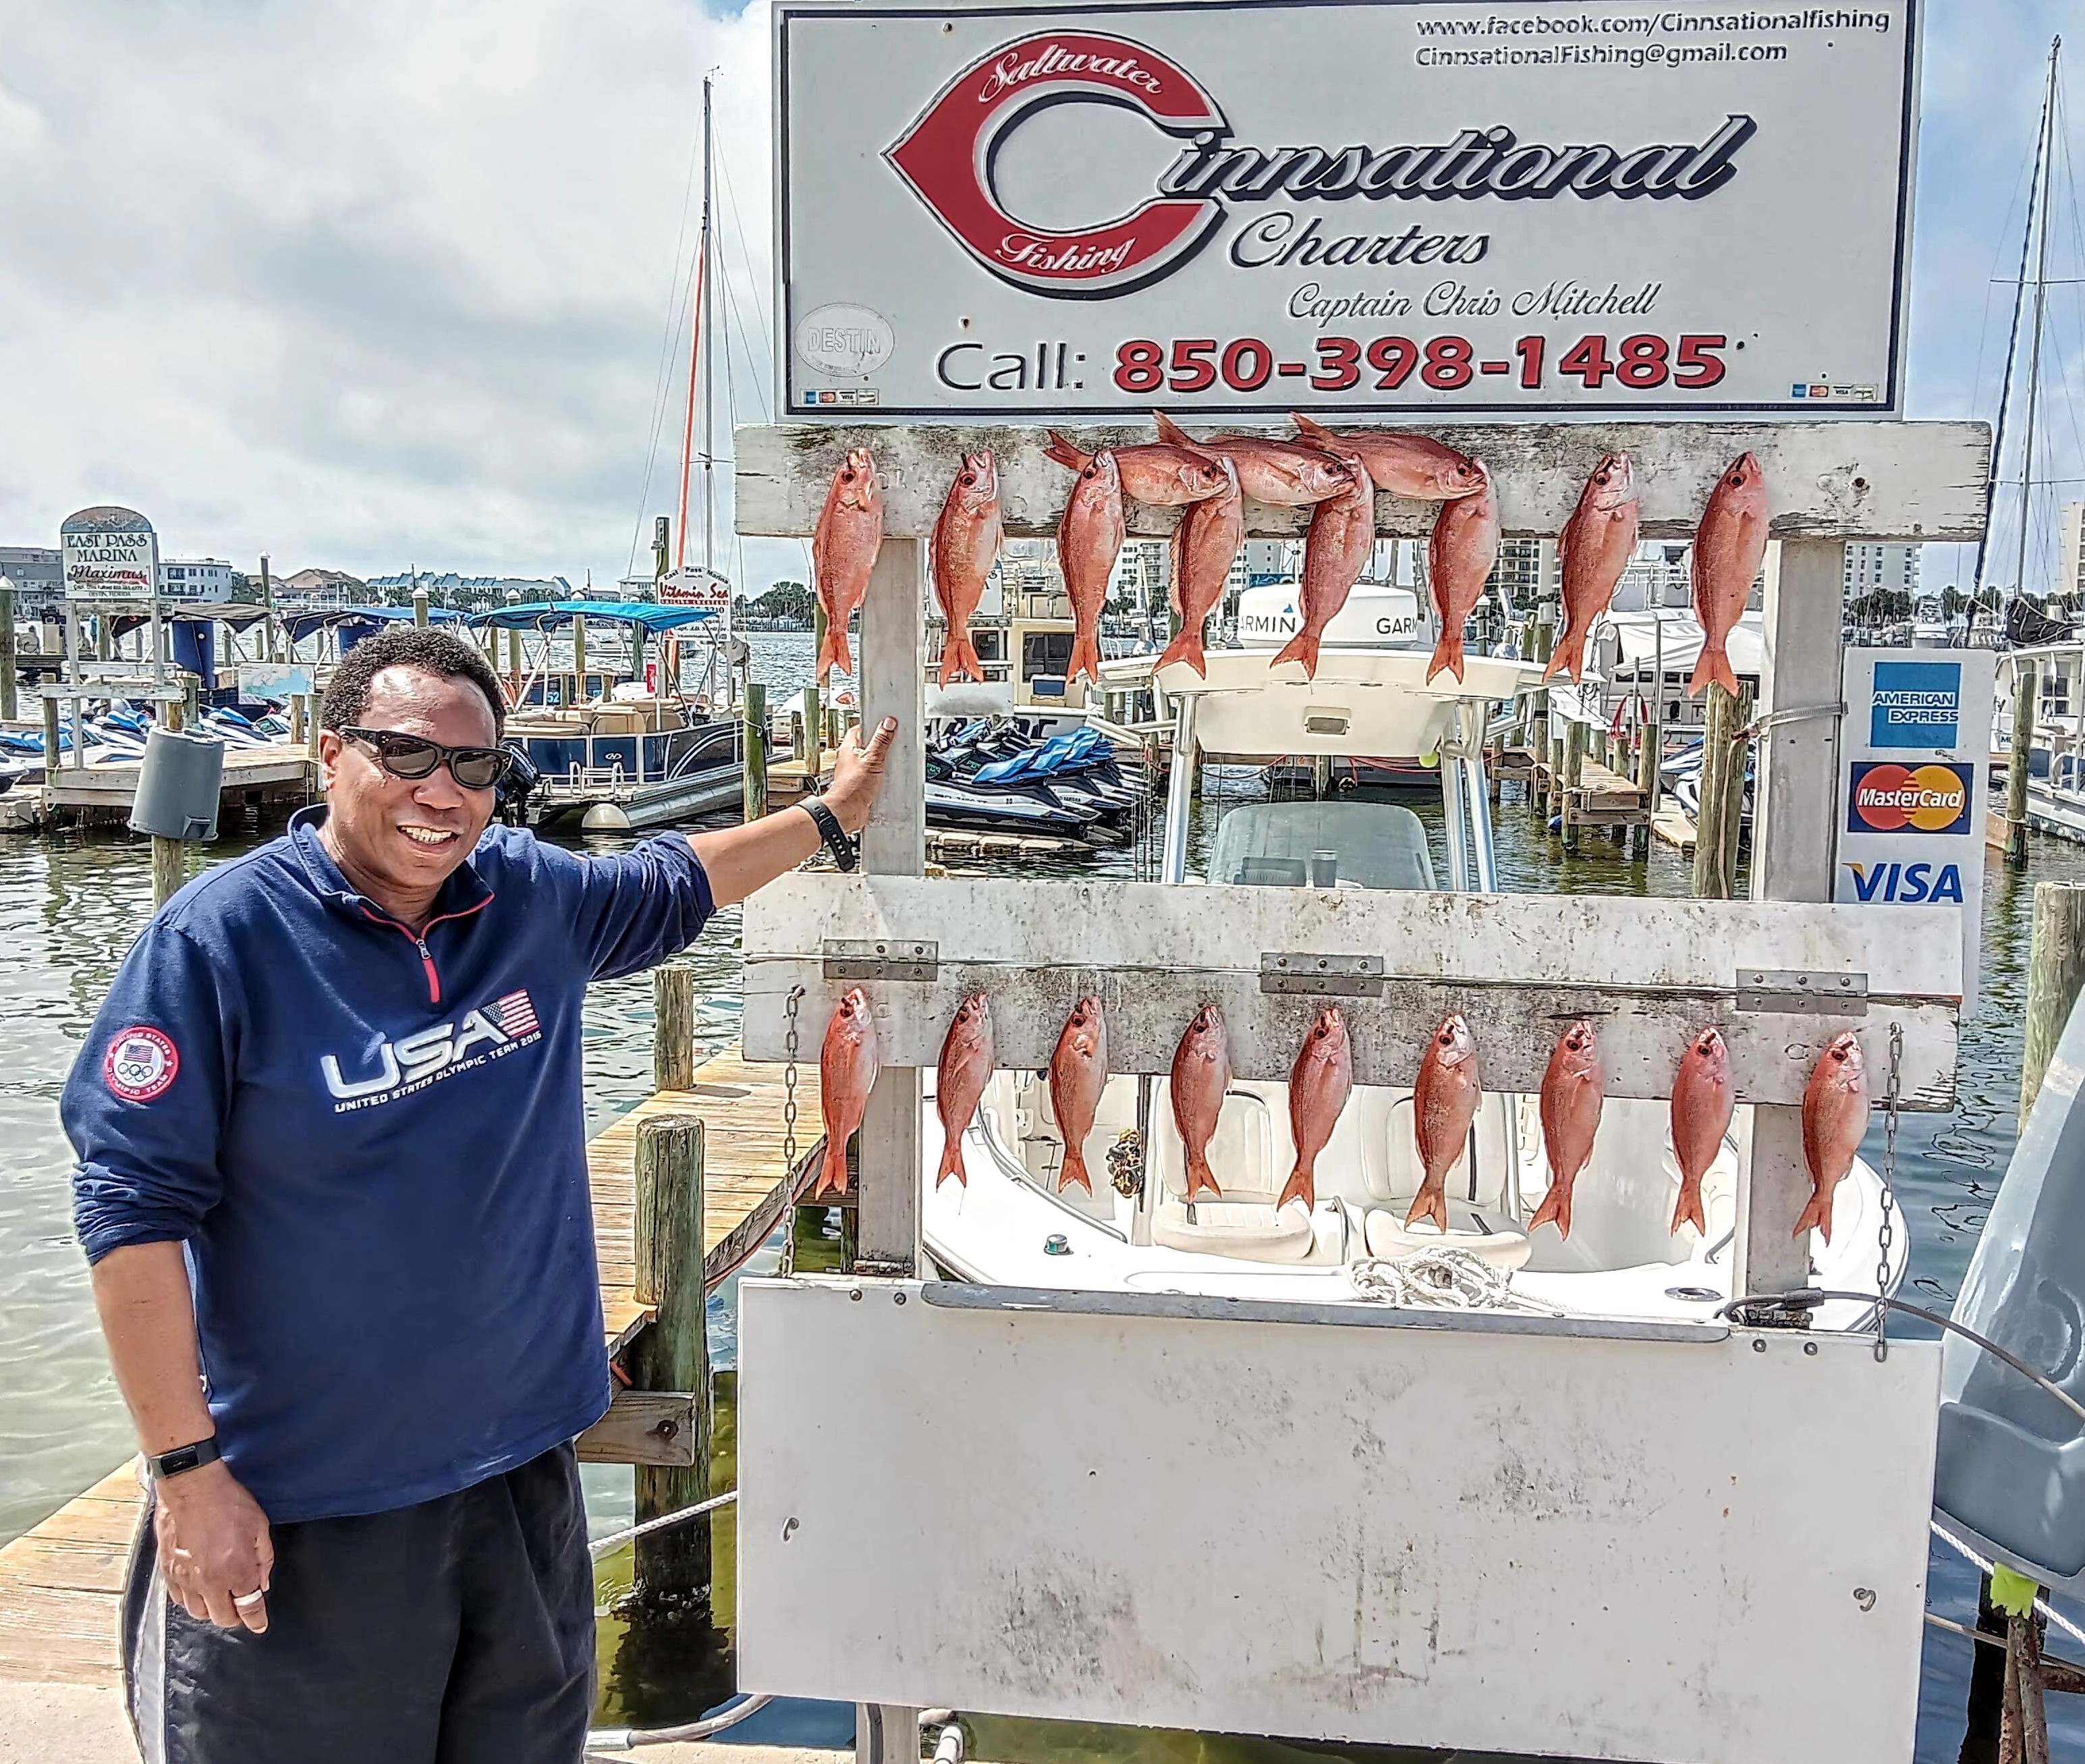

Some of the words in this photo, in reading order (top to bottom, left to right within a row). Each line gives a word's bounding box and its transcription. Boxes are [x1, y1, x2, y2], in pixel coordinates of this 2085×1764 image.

[1416, 10, 1890, 38] www.facebook.com/Cinnsationalfishing
[1416, 43, 1787, 68] CinnsationalFishing@gmail.com
[978, 44, 1163, 105] Saltwater
[1229, 211, 1489, 269] Charters
[995, 232, 1136, 274] Fishing
[1287, 282, 1412, 330] Captain
[1422, 280, 1501, 319] Chris
[1511, 280, 1663, 321] Mitchell
[808, 327, 881, 354] DESTIN
[936, 340, 1086, 391] Call:
[1113, 334, 1727, 393] 850-398-1485
[67, 534, 101, 548] EAST
[105, 534, 147, 547] PASS
[77, 549, 138, 562] MARINA
[71, 565, 144, 579] Maximus
[664, 570, 679, 580] East
[706, 570, 729, 584] Marina
[660, 582, 704, 599] Vitamin
[710, 582, 729, 599] Sea
[547, 691, 560, 703] 52
[1872, 692, 1955, 707] AMERICAN
[1889, 709, 1959, 724] EXPRESS
[1858, 788, 1964, 808] MasterCard
[1841, 862, 1964, 903] VISA
[146, 1032, 171, 1055] STATES
[320, 1009, 509, 1099] USA
[145, 1074, 169, 1093] TEAM
[335, 1093, 389, 1113] UNITED
[392, 1075, 434, 1101] STATES
[435, 1057, 488, 1082] OLYMPIC
[489, 1041, 520, 1060] TEAM
